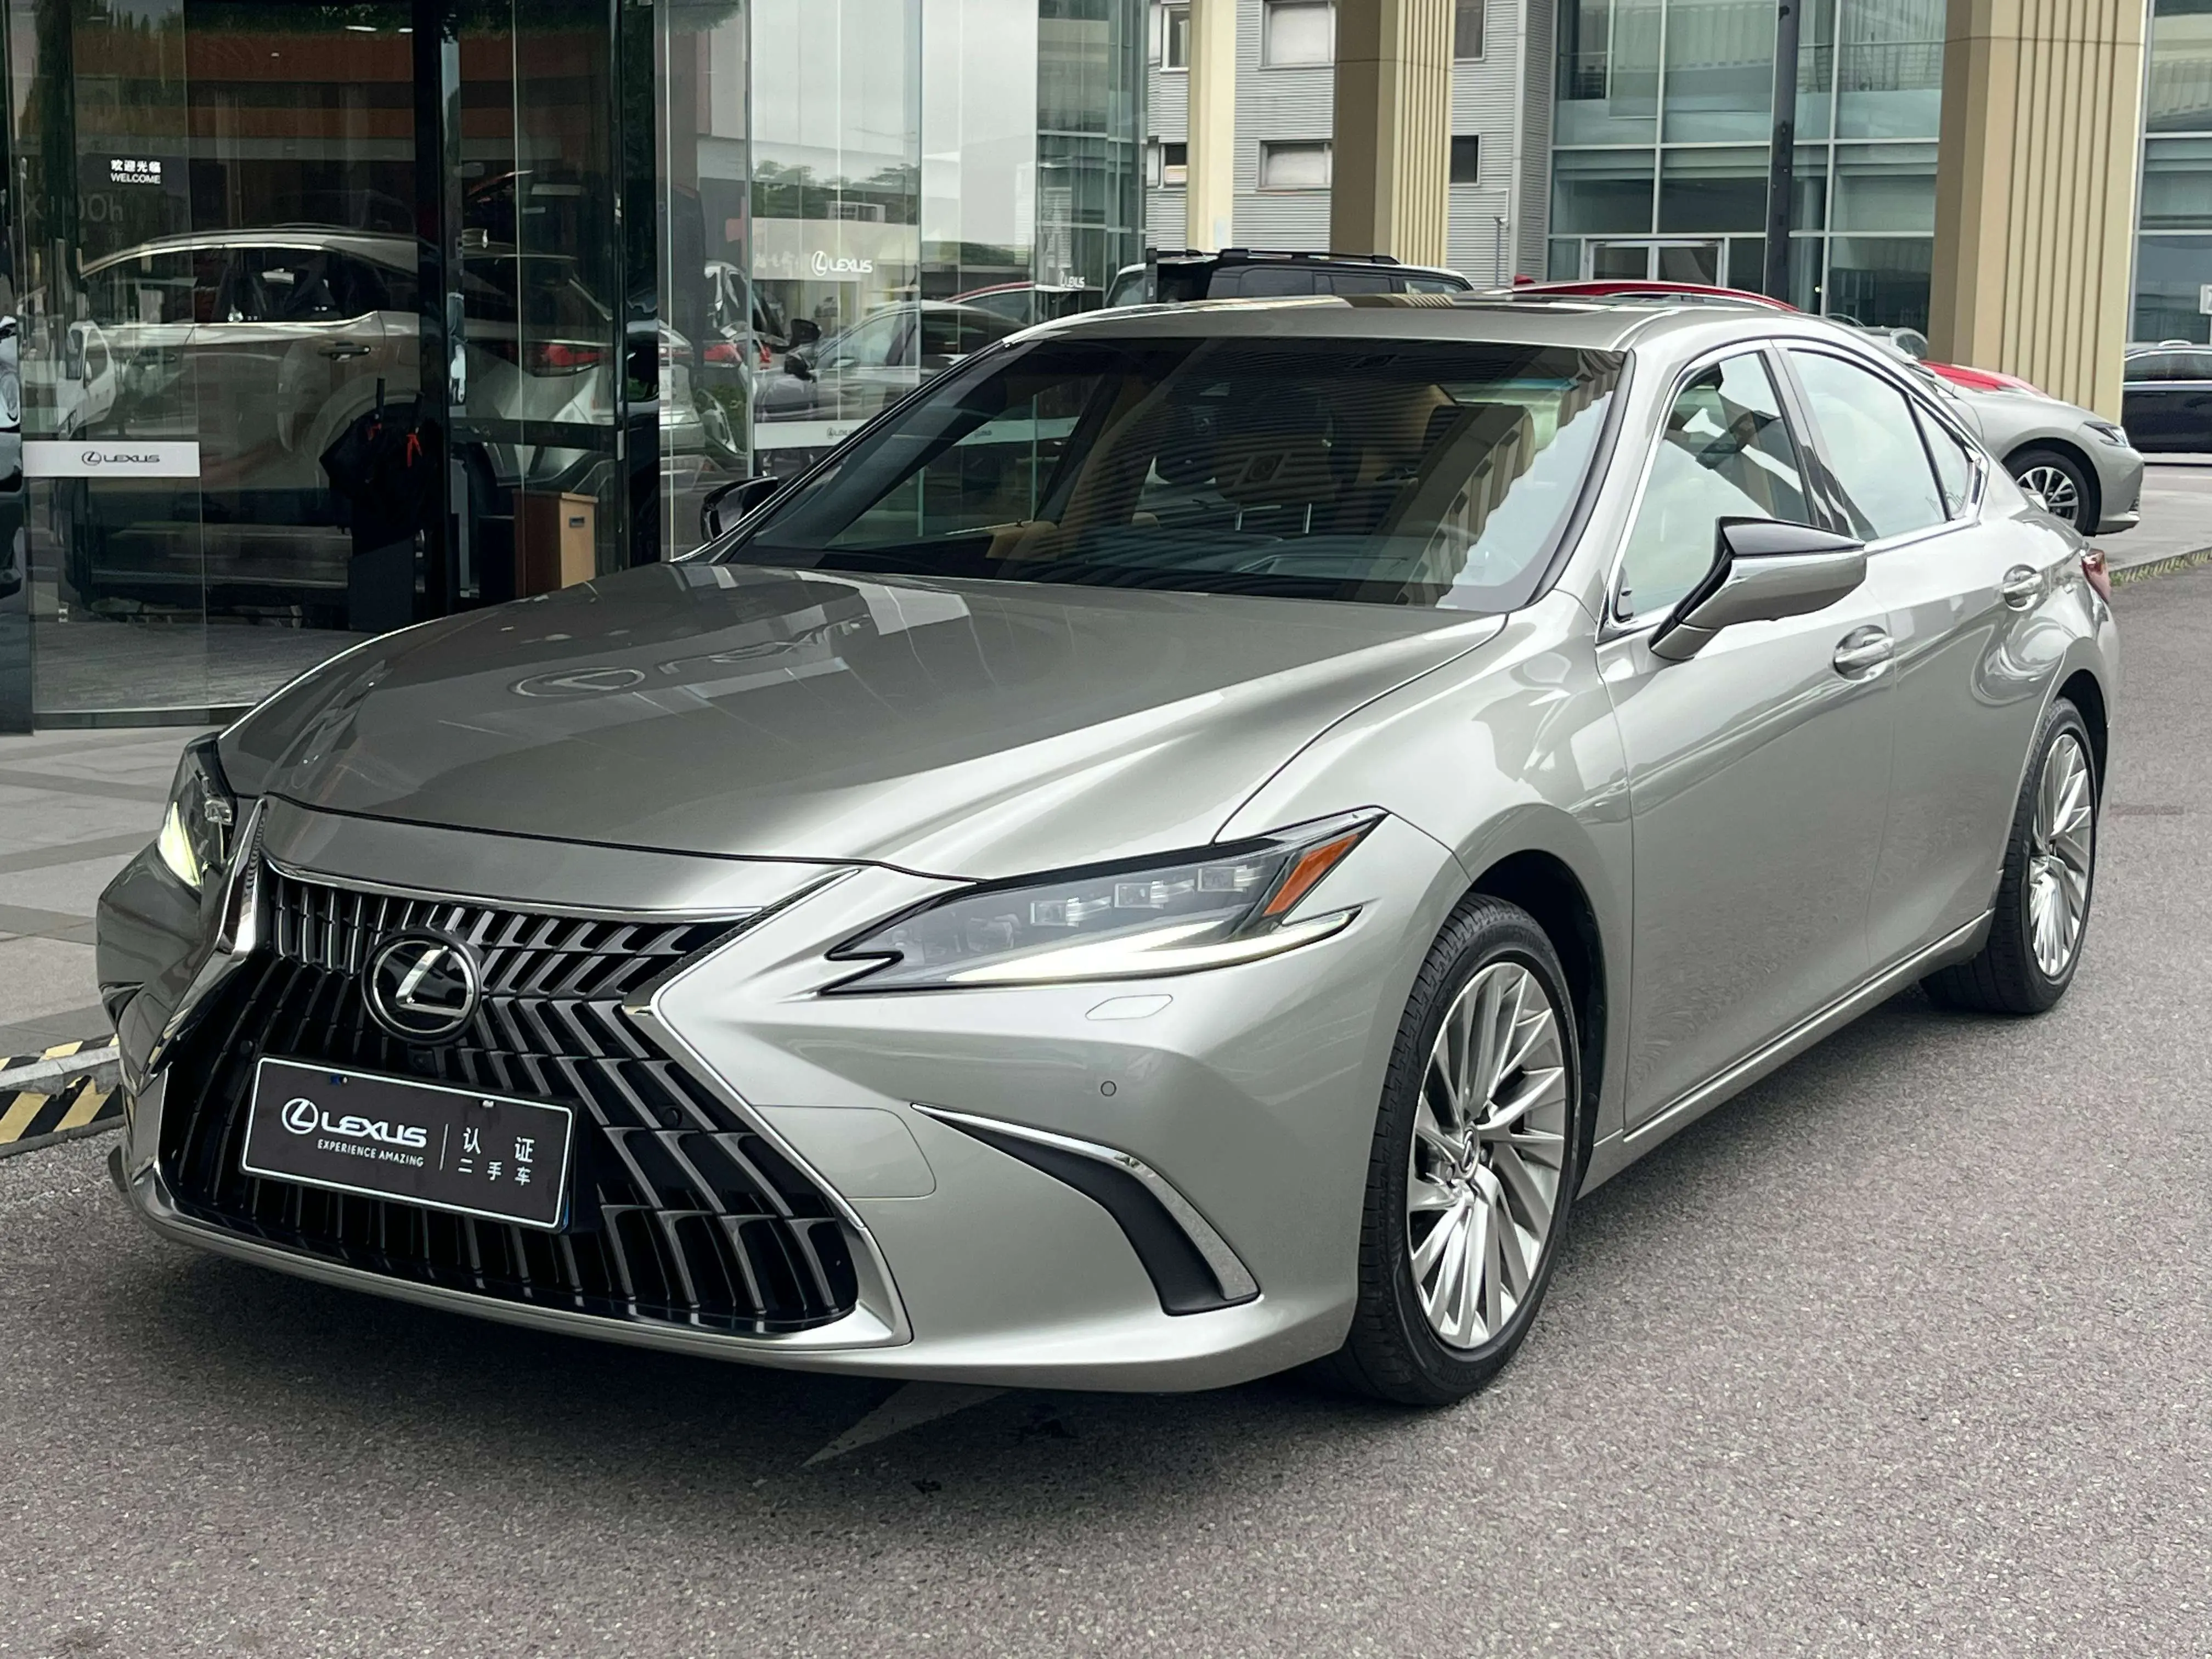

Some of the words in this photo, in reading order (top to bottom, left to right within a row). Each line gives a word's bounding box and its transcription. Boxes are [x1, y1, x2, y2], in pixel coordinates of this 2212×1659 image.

[110, 172, 161, 184] WELCOME
[829, 258, 873, 273] LEXUS
[103, 454, 160, 463] LEXUS
[321, 1111, 427, 1148] LEXUS
[317, 1138, 377, 1159] EXPERIENCE
[378, 1150, 424, 1167] AMAZING
[463, 1127, 535, 1163] 认证
[458, 1158, 532, 1187] 二手车
